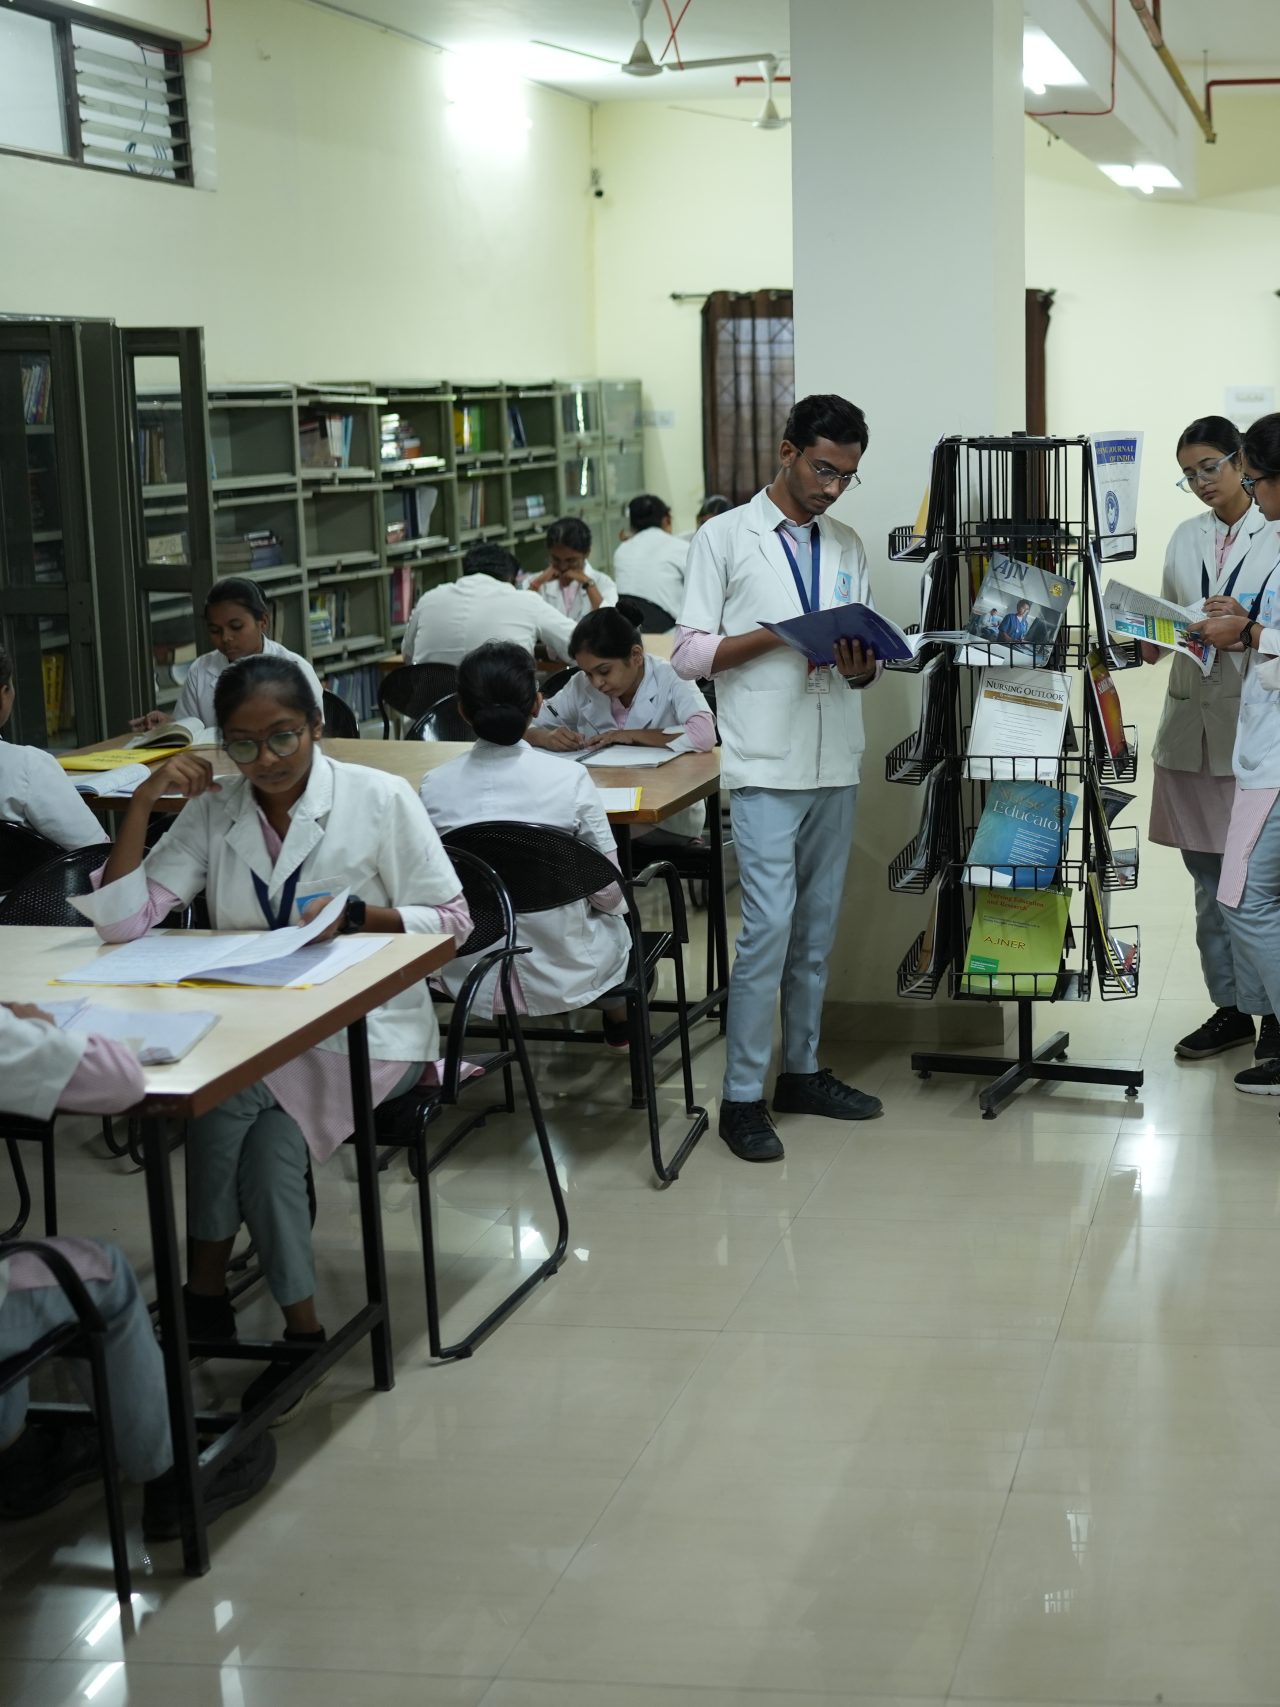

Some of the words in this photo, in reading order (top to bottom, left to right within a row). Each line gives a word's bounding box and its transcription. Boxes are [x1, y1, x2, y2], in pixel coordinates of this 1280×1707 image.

[992, 559, 1029, 580] AJN
[985, 680, 1023, 695] NURSING
[1023, 687, 1065, 702] OUTLOOK
[984, 936, 1026, 950] AJNER
